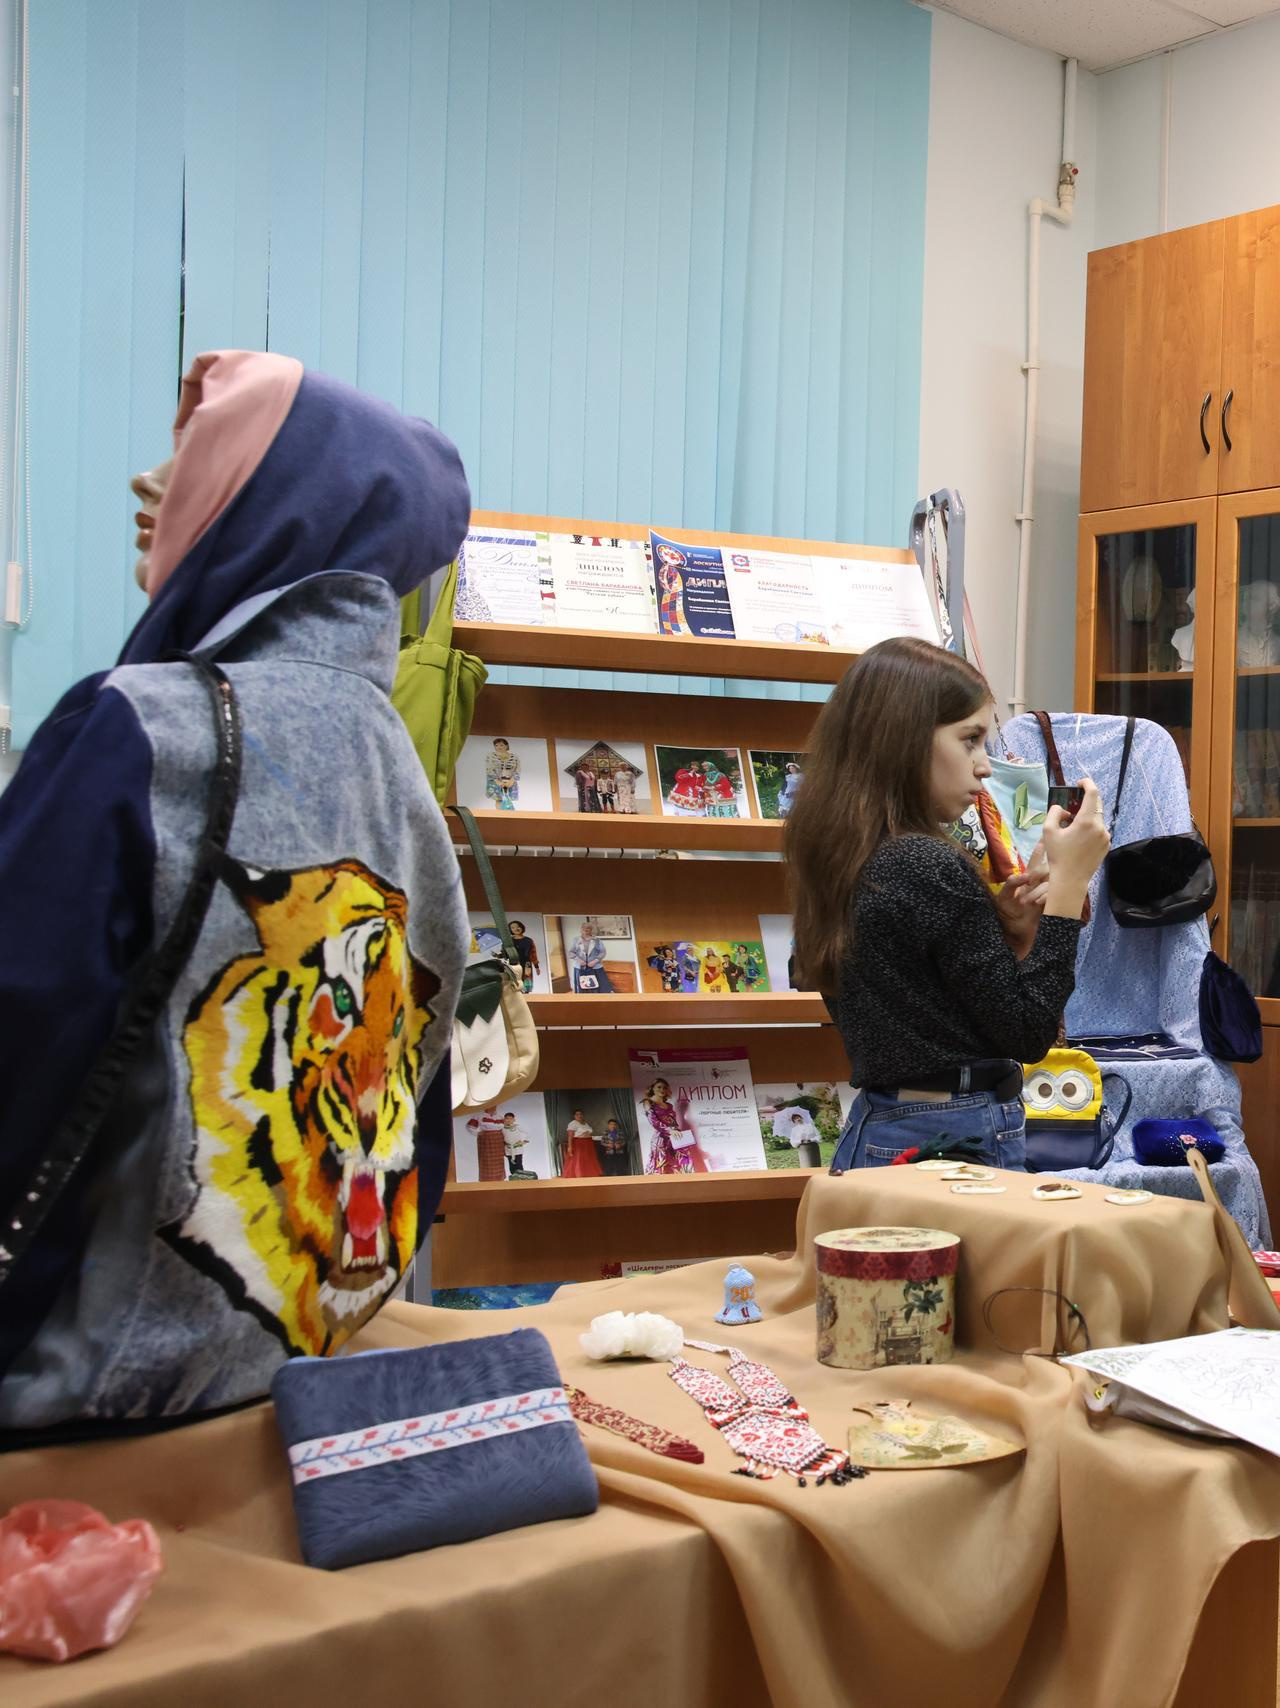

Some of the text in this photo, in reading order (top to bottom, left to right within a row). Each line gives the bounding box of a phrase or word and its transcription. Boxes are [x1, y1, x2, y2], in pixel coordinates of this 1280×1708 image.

[576, 561, 624, 573] ДИПЛОМ
[757, 581, 809, 590] БЛАГОДАРНОСТЬ
[848, 583, 896, 592] ДИПЛОМ
[677, 1084, 747, 1103] ДИПЛОМ
